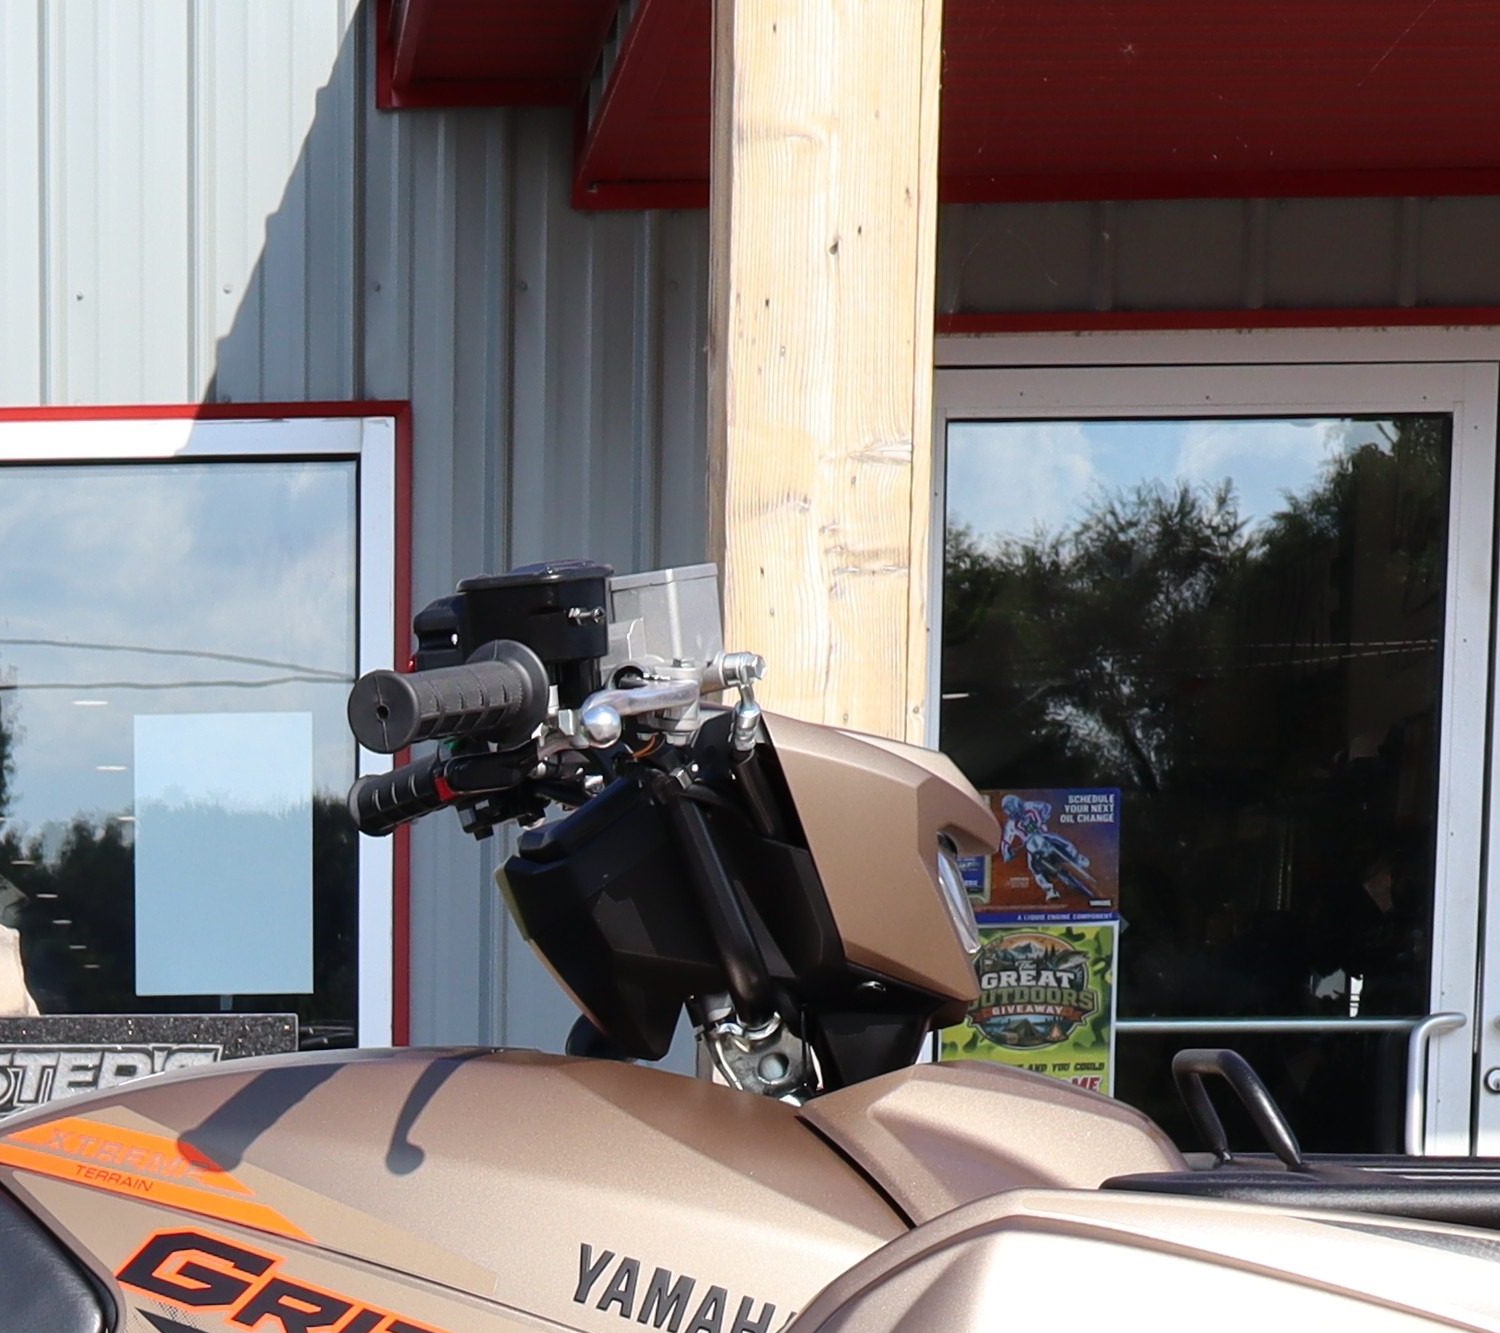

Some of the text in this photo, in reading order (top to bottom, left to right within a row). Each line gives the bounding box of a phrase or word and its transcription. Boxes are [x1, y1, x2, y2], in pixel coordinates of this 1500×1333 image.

[1068, 794, 1115, 804] SCHEDULE
[1064, 804, 1115, 813] YOUR NEXT
[1060, 813, 1115, 823] OIL CHANGE
[981, 970, 1075, 989] GREAT
[992, 1005, 1064, 1015] GIVEAWAY
[1052, 1063, 1071, 1072] YOU
[1074, 1062, 1105, 1071] COULD
[45, 1128, 210, 1181] XTREME
[75, 1164, 154, 1193] TERRAIN
